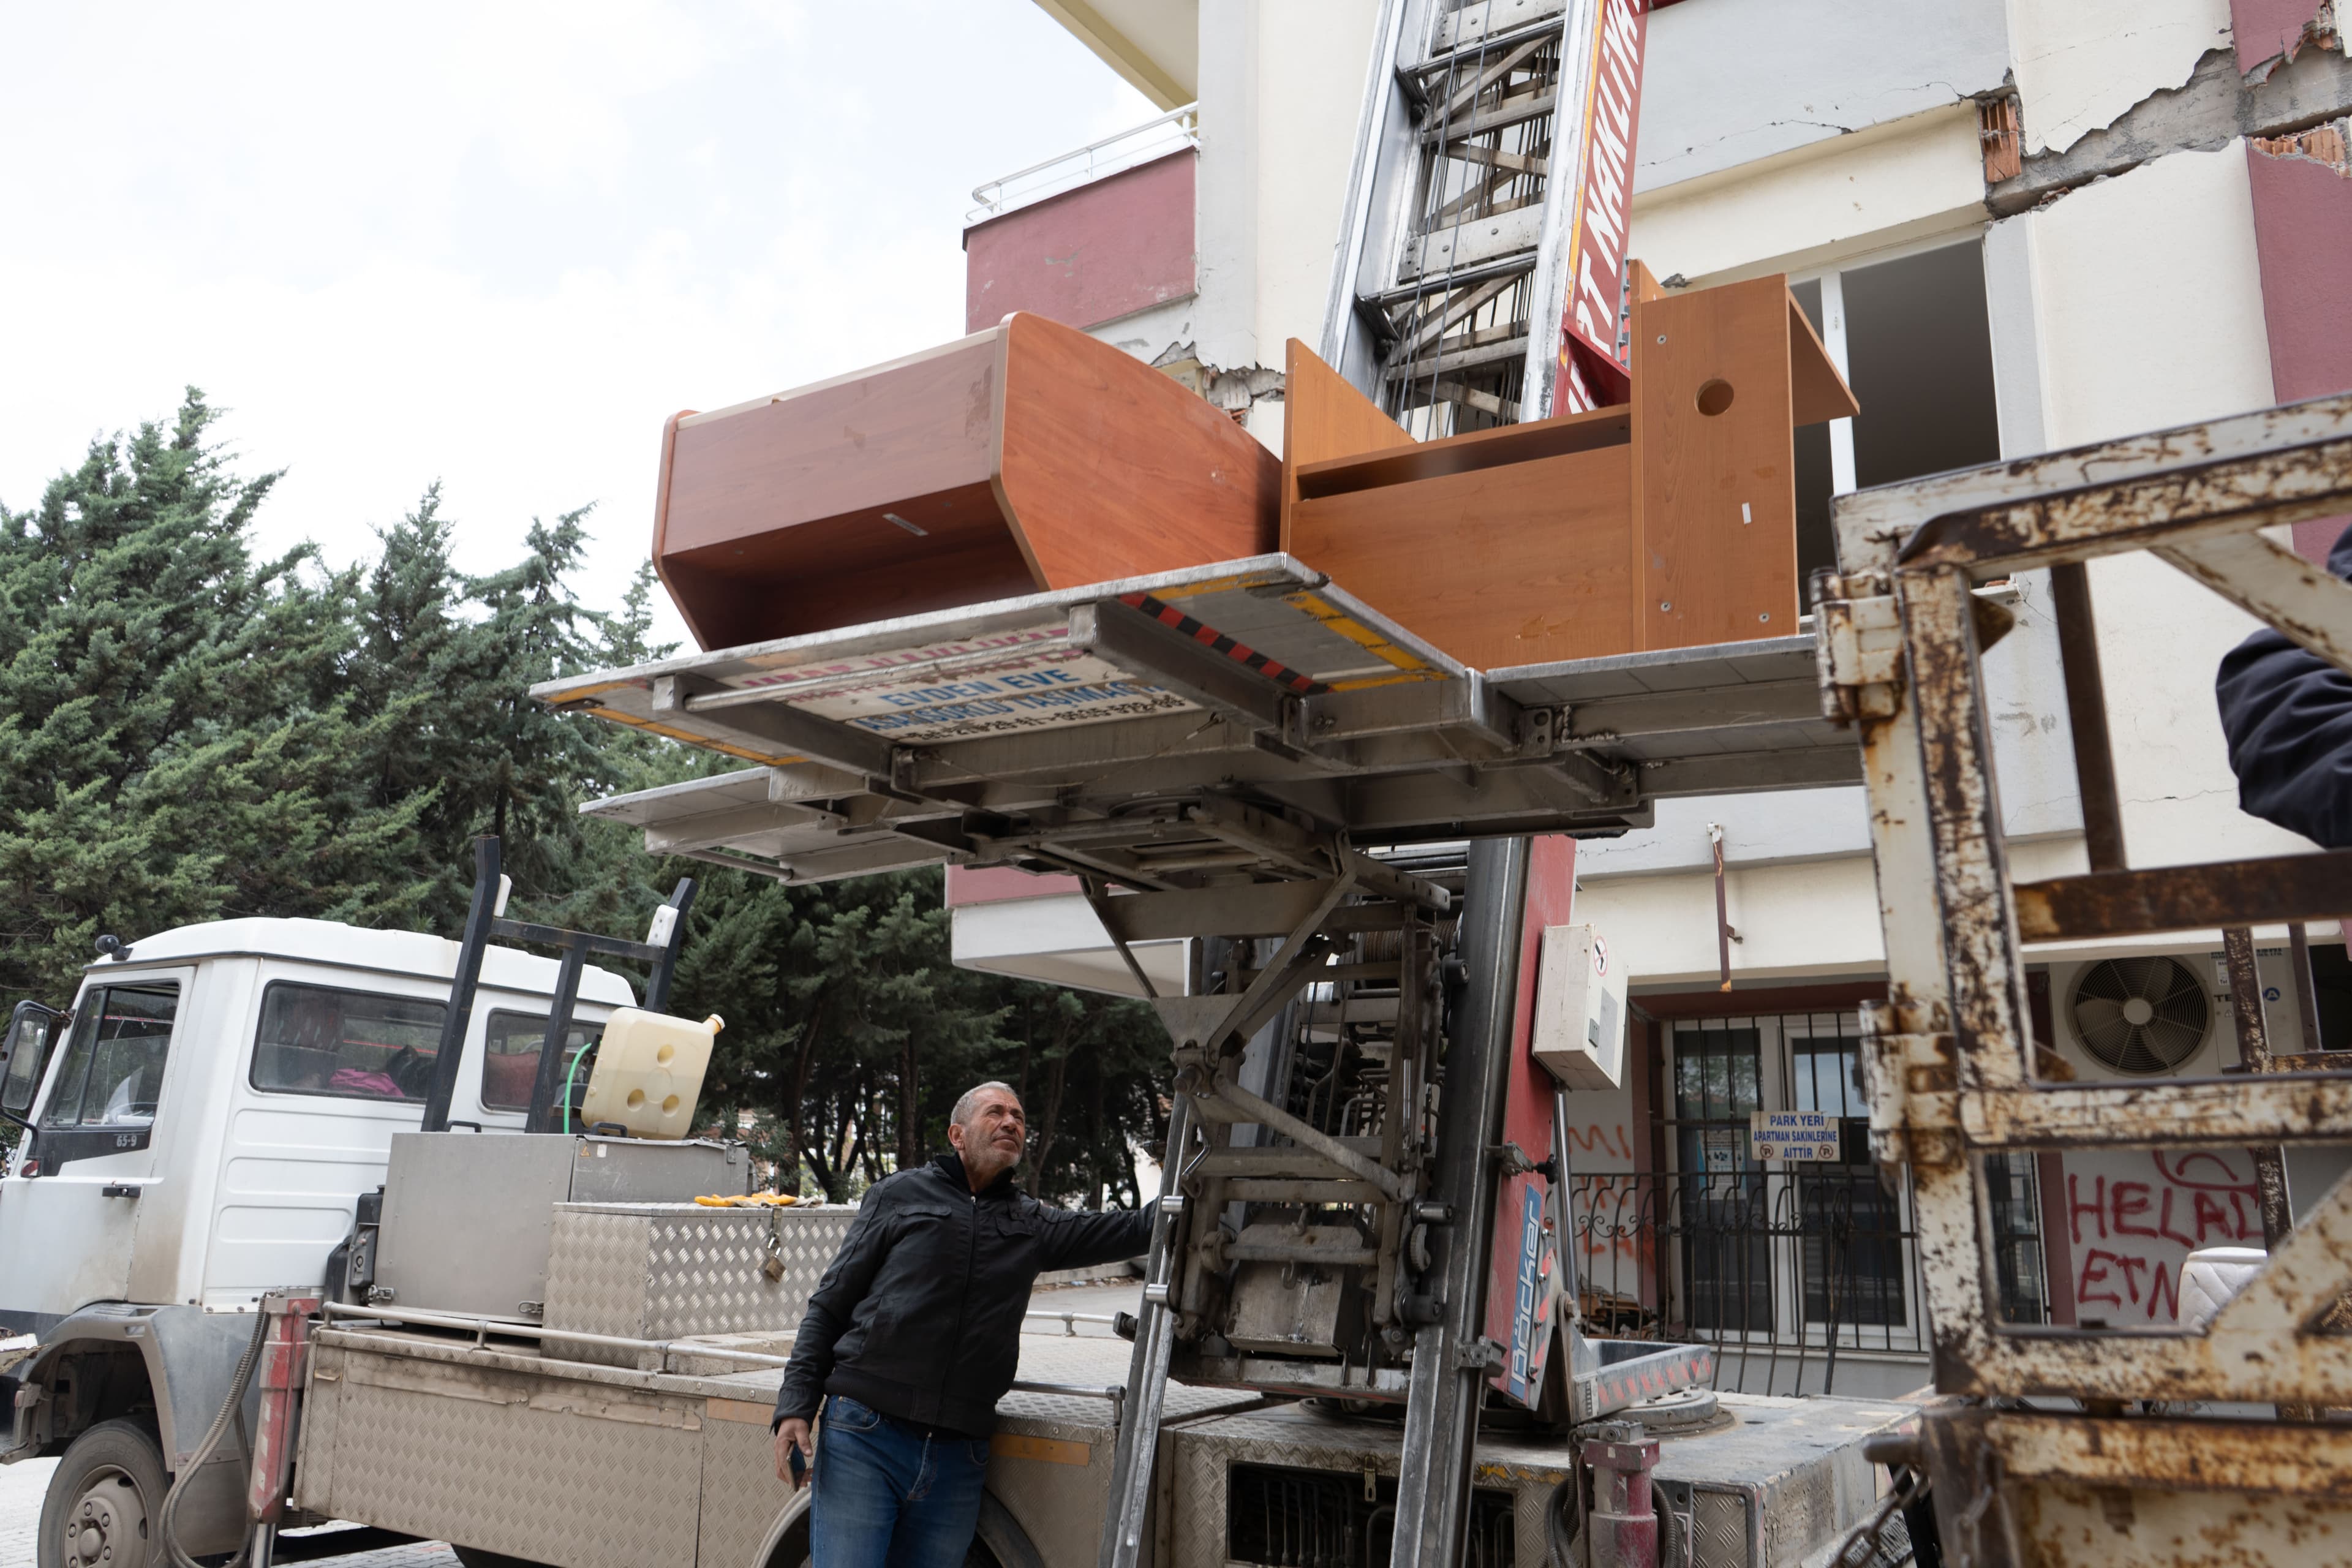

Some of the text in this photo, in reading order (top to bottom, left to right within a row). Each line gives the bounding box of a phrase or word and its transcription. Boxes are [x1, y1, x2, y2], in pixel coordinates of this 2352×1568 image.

[1586, 0, 1640, 277] NAKLİYA
[878, 669, 1081, 706] EVDEN EVE
[1770, 1113, 1824, 1126] PARK YERİ
[1754, 1130, 1790, 1142] APARTMAN
[1792, 1127, 1837, 1142] SAKİNLERİNE
[1783, 1144, 1813, 1158] AİTTİR
